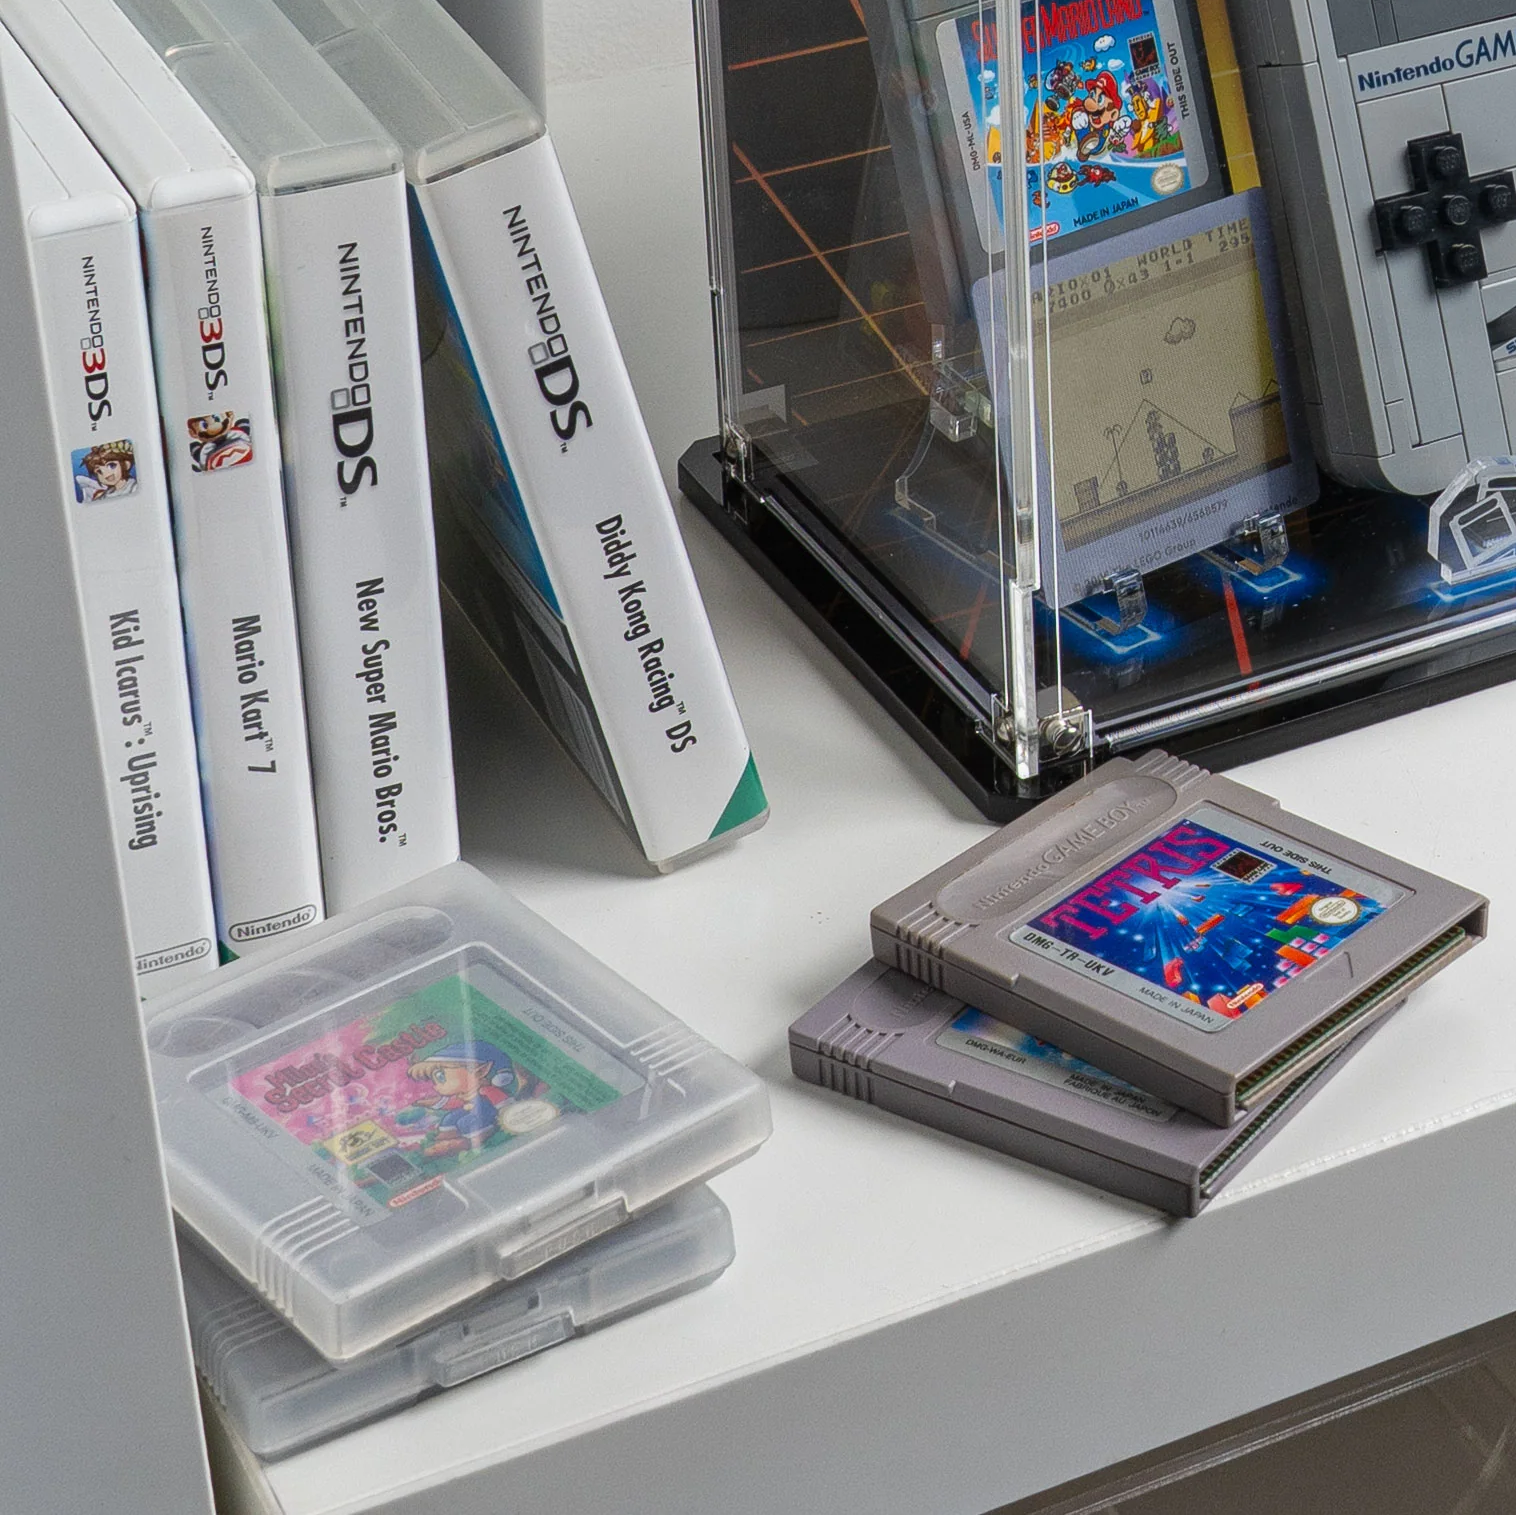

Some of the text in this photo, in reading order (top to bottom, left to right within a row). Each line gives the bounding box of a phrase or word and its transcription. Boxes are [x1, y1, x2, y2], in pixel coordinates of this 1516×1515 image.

[1167, 41, 1190, 120] THIS SIDE OUT
[1357, 55, 1455, 92] Nintendo
[1073, 197, 1140, 228] MADE IN JAPAN
[1137, 239, 1193, 268] WORLD
[1205, 218, 1250, 244] TIME
[81, 255, 104, 349] NINTENDO
[200, 226, 222, 319] NINTENDO
[502, 204, 569, 358] NINTENDO
[199, 317, 229, 391] 3DS
[337, 241, 372, 407] NINTENDO
[82, 347, 113, 422] 3DS
[534, 354, 594, 441] DS
[331, 406, 379, 496] DS
[109, 609, 145, 651] Kid
[355, 576, 385, 632] New
[595, 513, 637, 580] Diddy
[617, 579, 651, 642] Kong
[665, 719, 698, 753] DS
[231, 614, 265, 685] Mario
[355, 639, 390, 704] Super
[247, 759, 277, 774] 7
[368, 710, 400, 779] Mario
[119, 751, 163, 852] Uprising
[975, 858, 1050, 910] Nintendo
[1041, 821, 1105, 866] GAME
[1041, 825, 1232, 940] TETRIS
[1258, 840, 1334, 876] THIS SIDE OUT
[236, 910, 311, 939] Nintendo
[1022, 931, 1116, 977] DMG-TR-UKV
[1138, 986, 1214, 1025] MADE IN JAPAN
[965, 1038, 1027, 1065] DMG-WA-EUR
[1111, 1094, 1126, 1104] AU
[1126, 1101, 1163, 1118] JAPON
[1113, 1087, 1146, 1104] JAPAN
